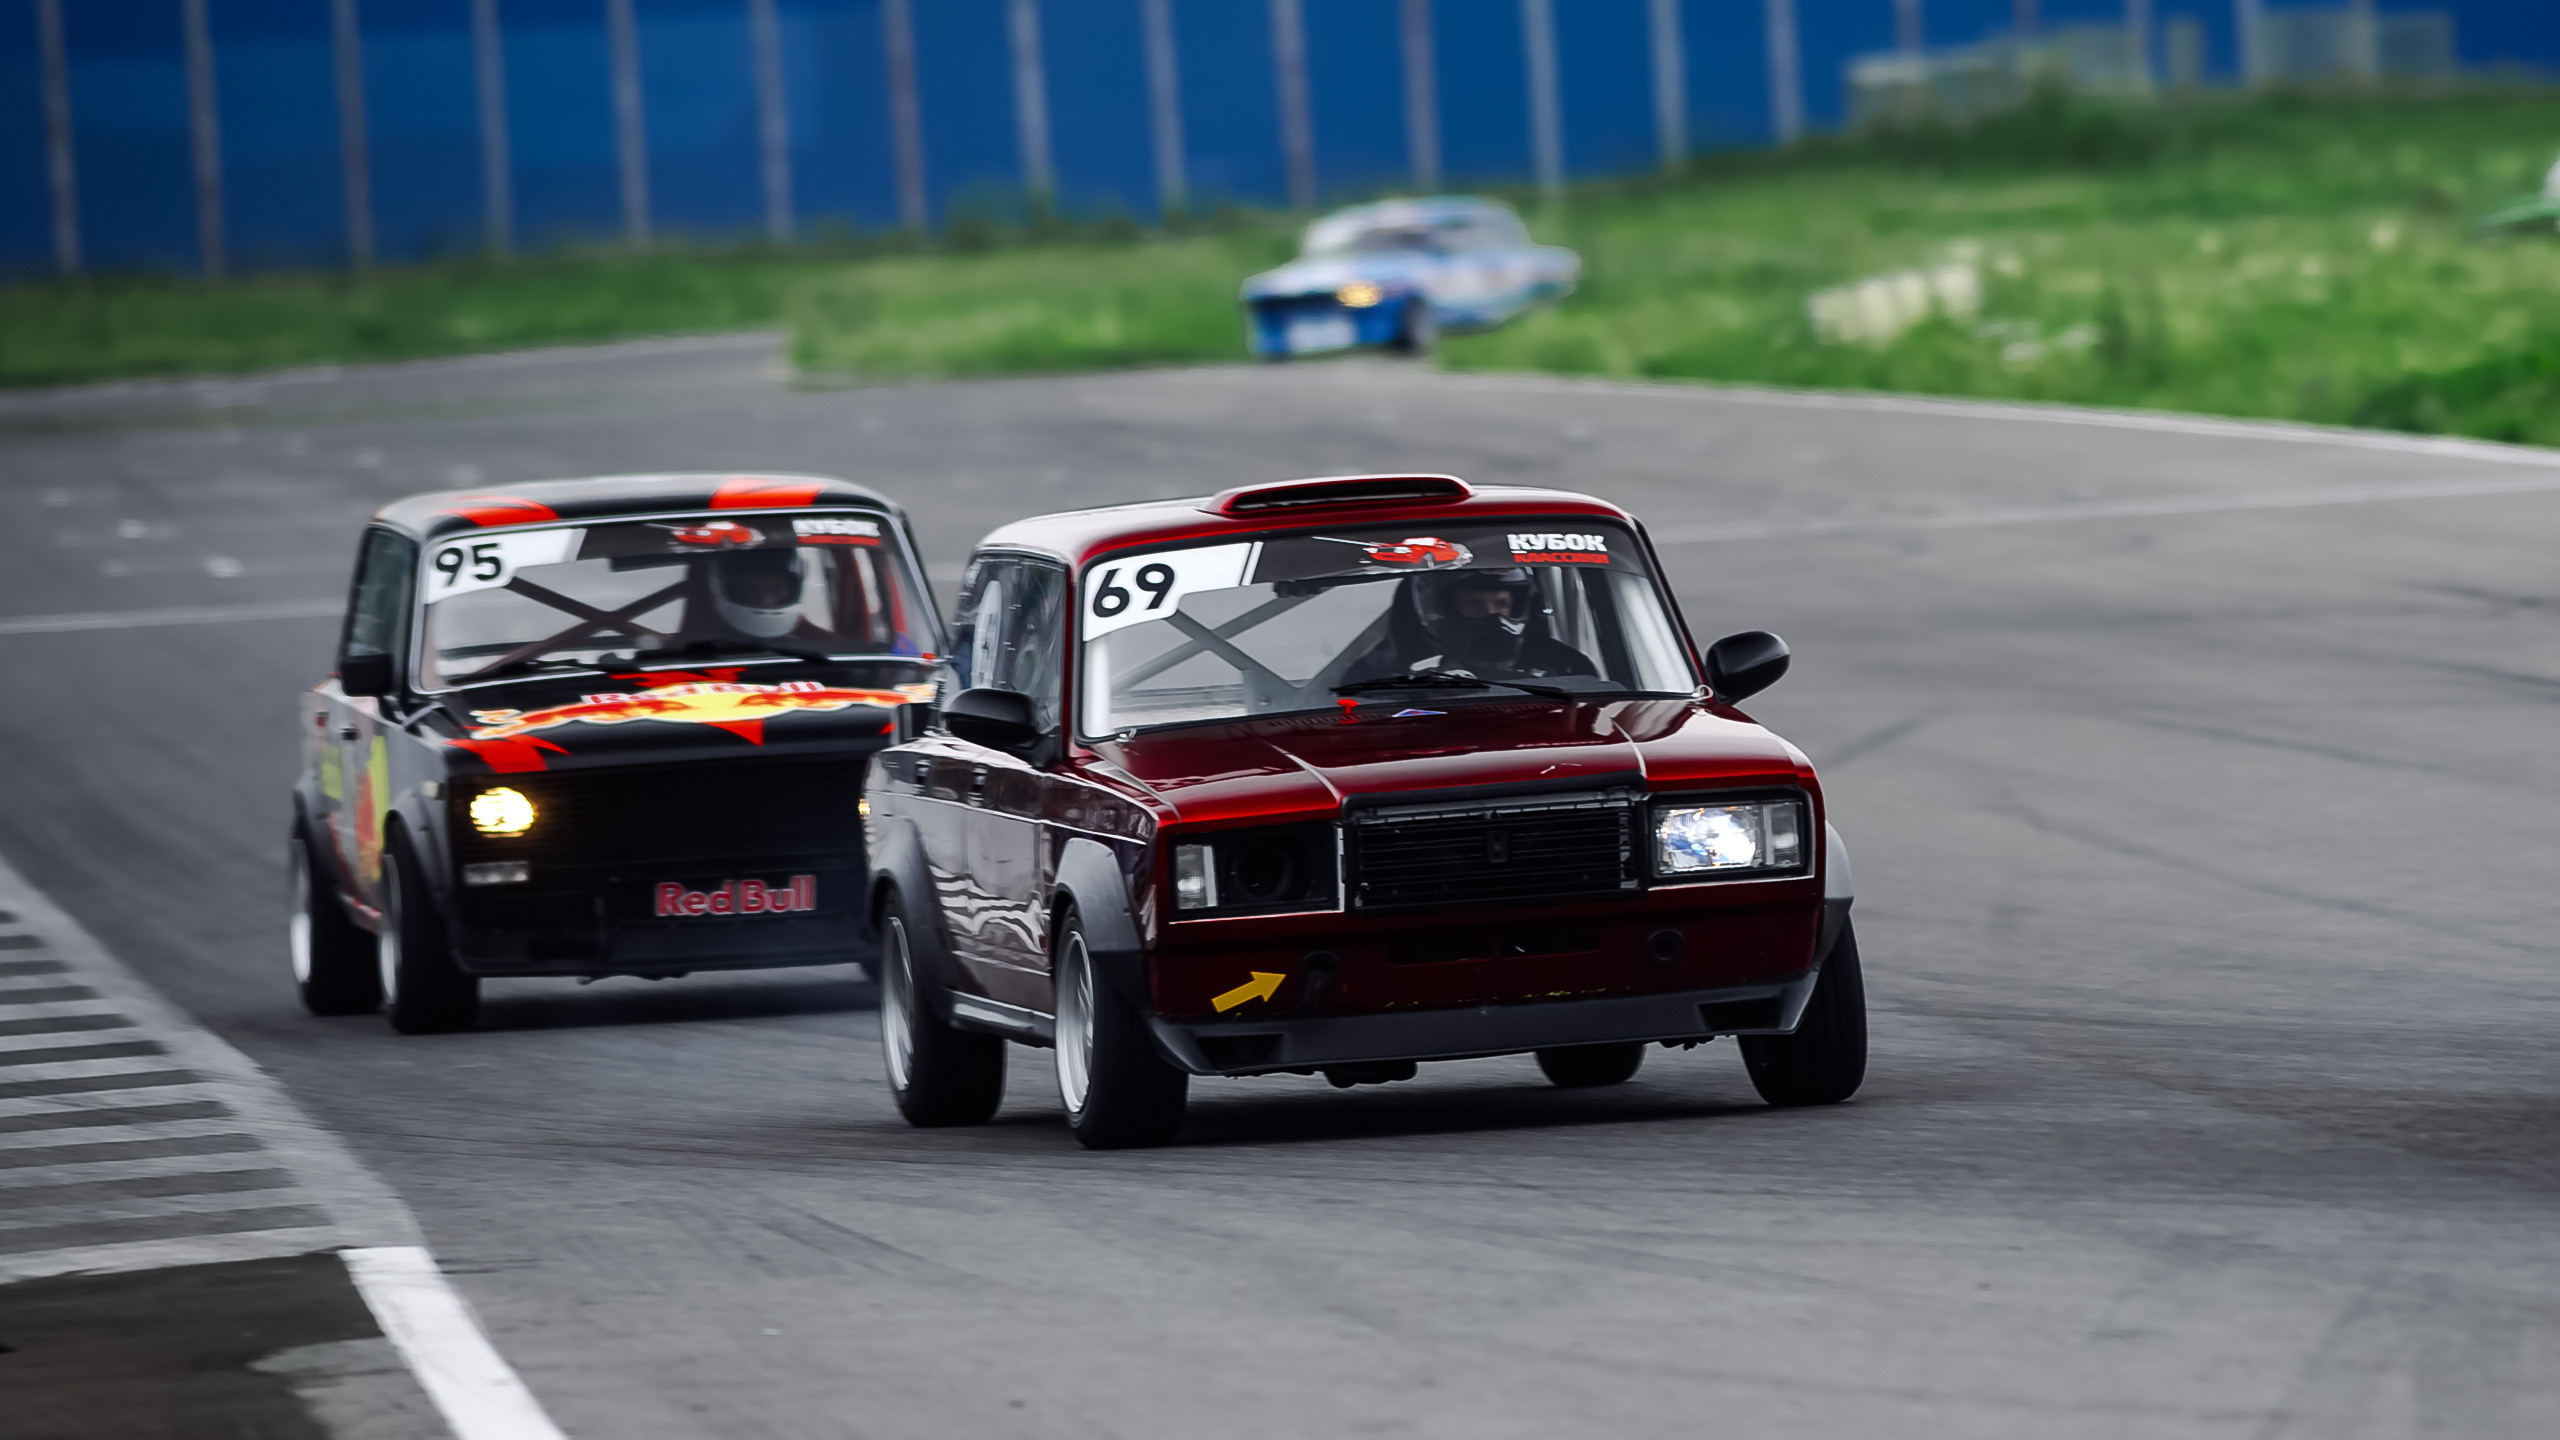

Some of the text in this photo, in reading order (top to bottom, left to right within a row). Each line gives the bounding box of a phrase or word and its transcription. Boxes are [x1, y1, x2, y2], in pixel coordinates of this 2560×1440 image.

[1507, 533, 1607, 551] КУБОК
[435, 543, 501, 586] 95
[1092, 563, 1175, 618] 69
[656, 875, 816, 916] Red Bull
